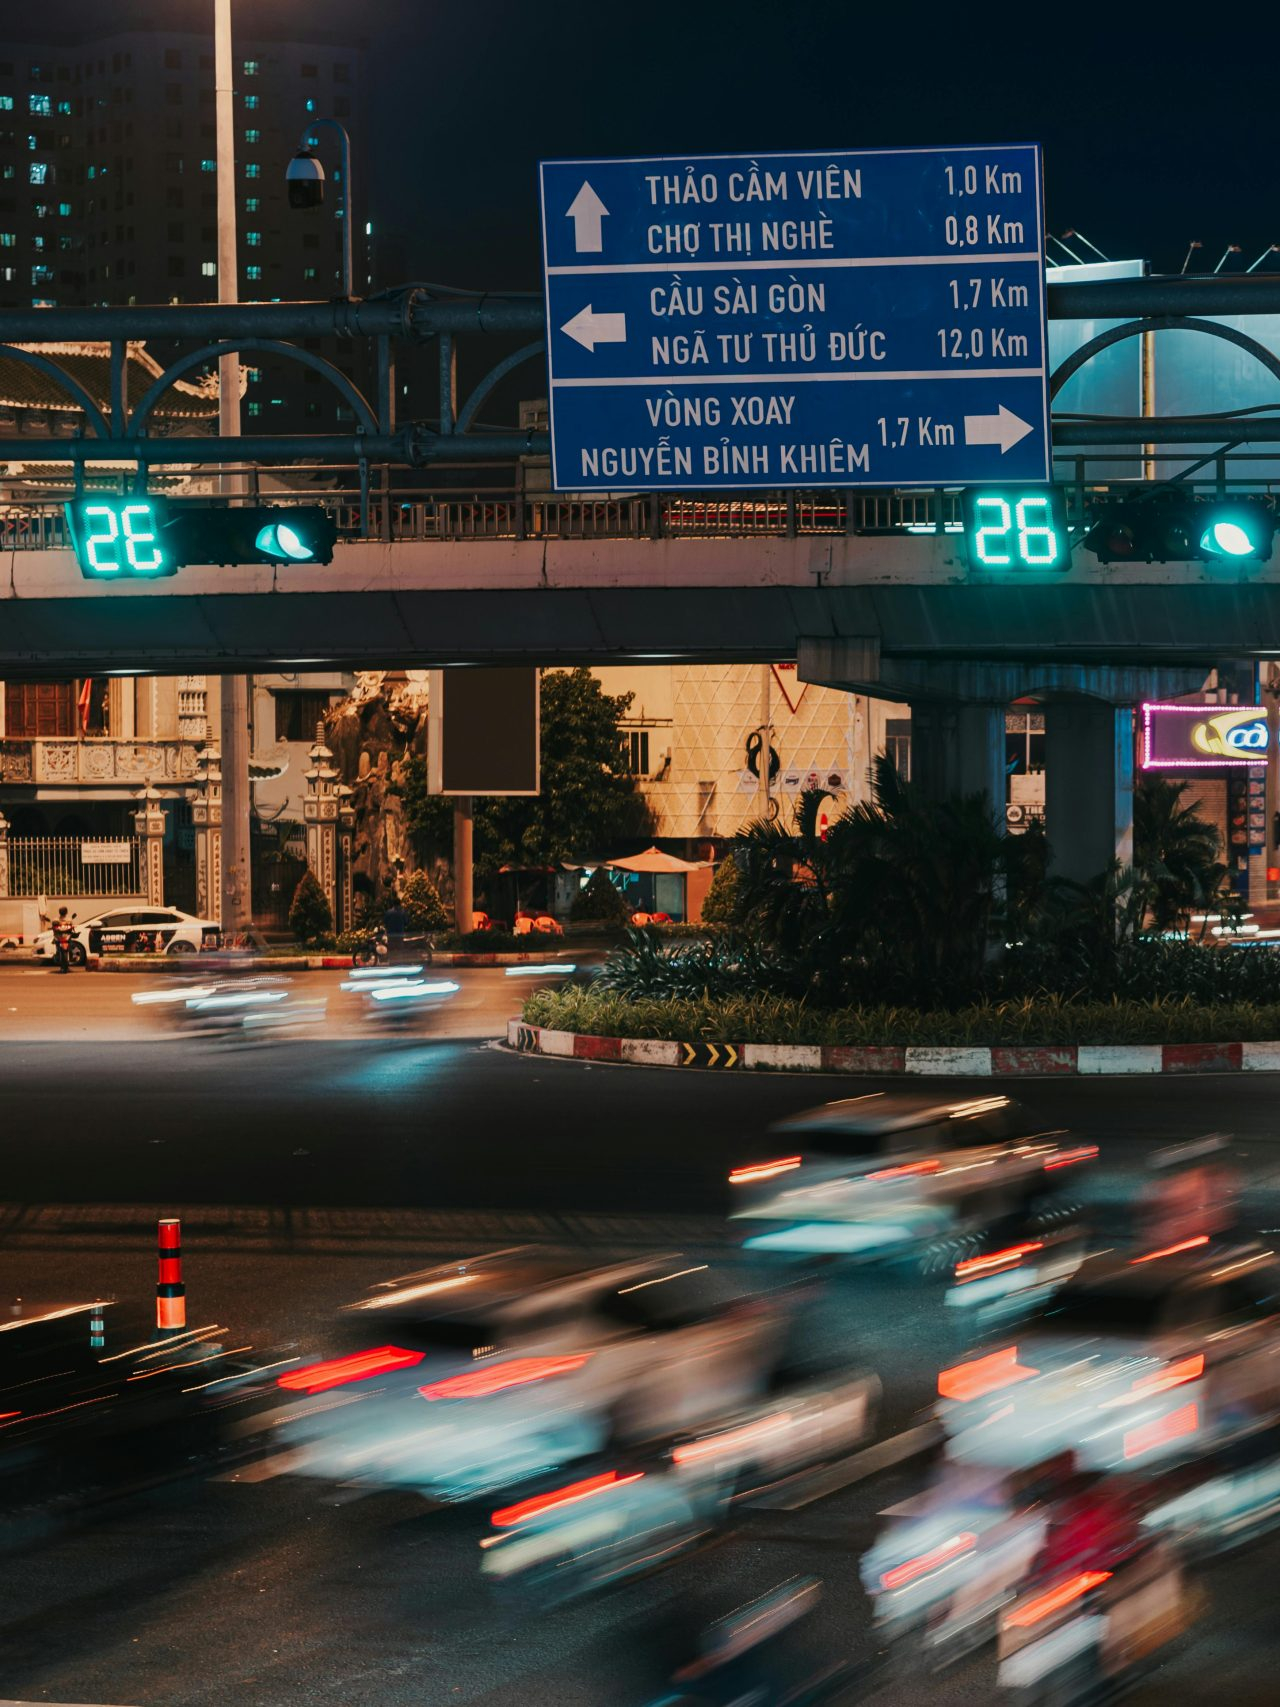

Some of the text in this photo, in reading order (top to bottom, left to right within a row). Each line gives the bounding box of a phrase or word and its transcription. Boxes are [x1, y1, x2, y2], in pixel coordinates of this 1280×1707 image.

[645, 161, 1021, 204] THẢO CẦM VIÊN 1,0 Km
[648, 211, 1023, 257] CHỢ THỊ NGHÈ 0,8 Km
[651, 274, 1027, 316] CẦU SÀI GÒN 1,7 Km
[652, 324, 1027, 364] NGÃ TƯ THỦ ĐỨC 12,0 Km
[646, 390, 795, 426] VÒNG XOAY
[878, 417, 954, 448] 1,7 Km
[582, 436, 869, 476] NGUYỄN BỈNH KHIÊM
[976, 498, 1057, 564] 26
